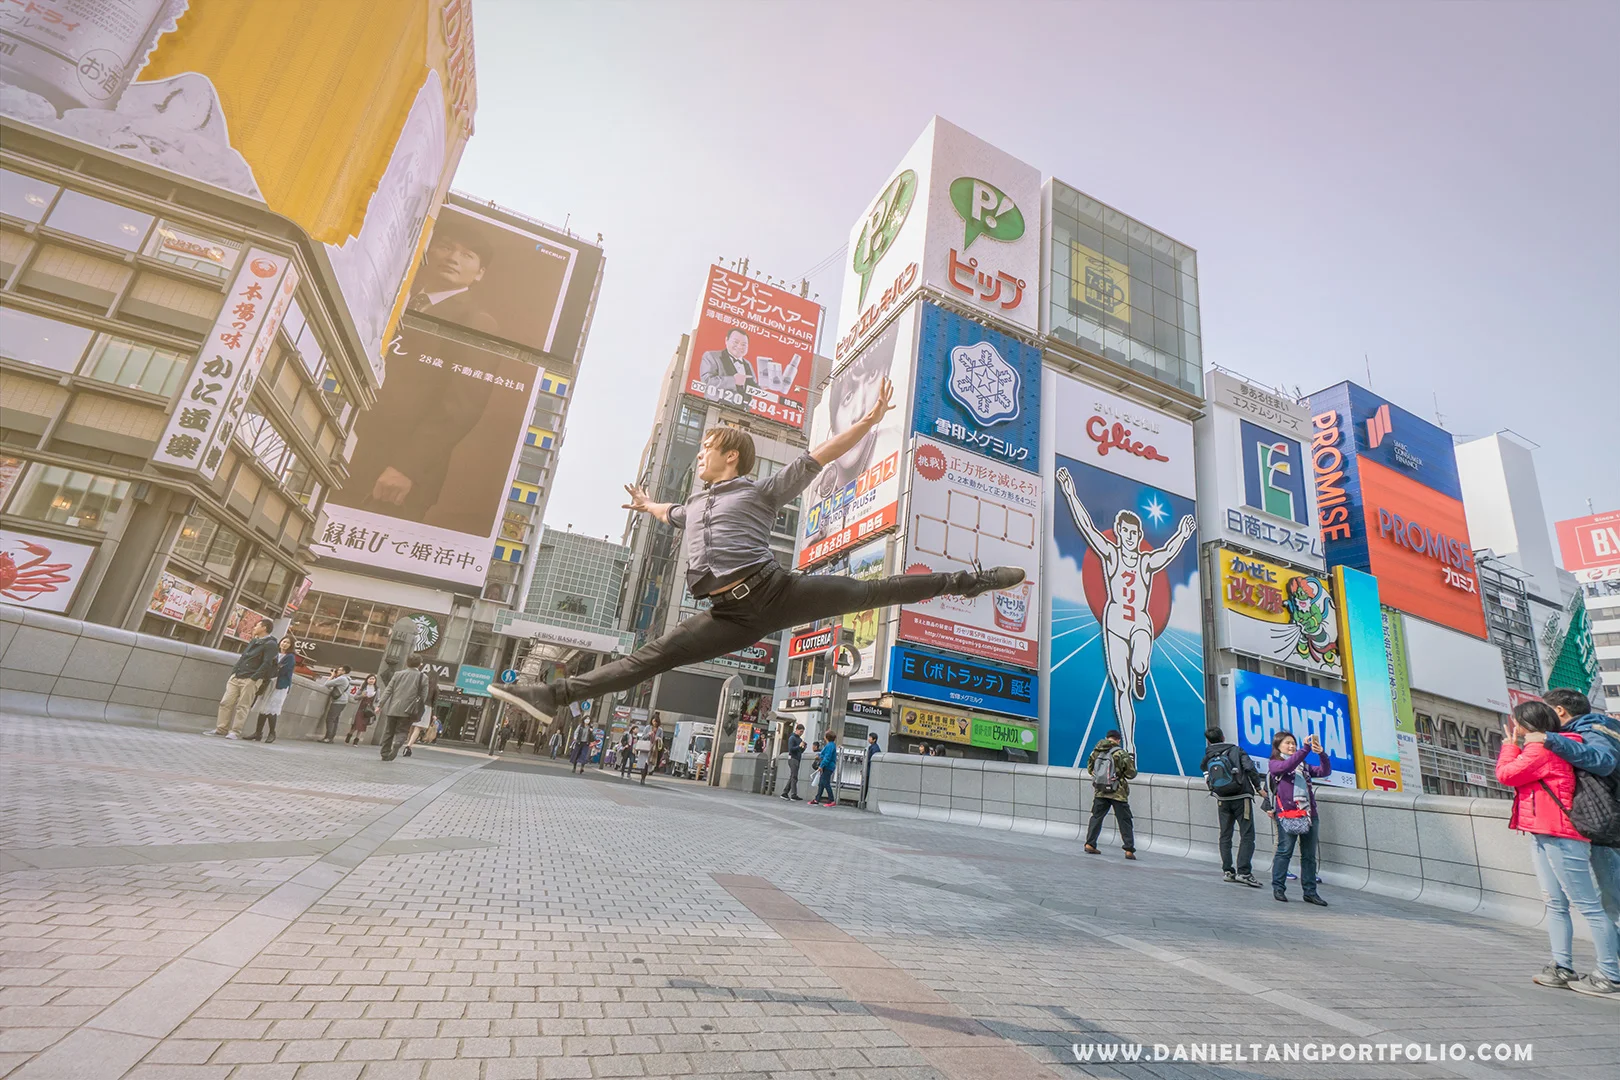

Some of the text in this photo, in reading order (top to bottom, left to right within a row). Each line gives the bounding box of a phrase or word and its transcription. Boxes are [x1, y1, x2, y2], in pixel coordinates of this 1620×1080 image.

[80, 56, 124, 96] お酒
[713, 269, 773, 298] スーパー
[948, 248, 1027, 310] ピップ
[218, 282, 263, 349] 本場の味
[708, 298, 813, 341] SUPER MILLION HAIR
[710, 283, 815, 328] ミリオンヘアー
[419, 353, 525, 392] 28歳 不動産業会社員
[706, 386, 803, 425] 0120-494-111
[1233, 396, 1299, 431] エステムシリーズ
[1240, 383, 1290, 412] 夢ある住まい
[934, 417, 1028, 461] 雪印メグミルク
[1086, 415, 1170, 463] Glico
[1394, 446, 1423, 467] CONSUMER
[949, 456, 1038, 497] 正方形を減らそう!
[1311, 409, 1351, 543] PROMISE
[1396, 454, 1419, 471] FINANCE
[322, 522, 483, 573] 縁結びで婚活中。
[1378, 508, 1473, 573] PROMISE
[1230, 556, 1278, 583] かぜに
[1441, 566, 1477, 595] プロミス
[1121, 570, 1136, 622] グリコ
[1225, 575, 1285, 615] 改源
[802, 633, 831, 651] LOTTERIA
[862, 705, 883, 716] Toilets
[1243, 688, 1348, 760] CHINTAI
[1371, 762, 1396, 776] スーパー
